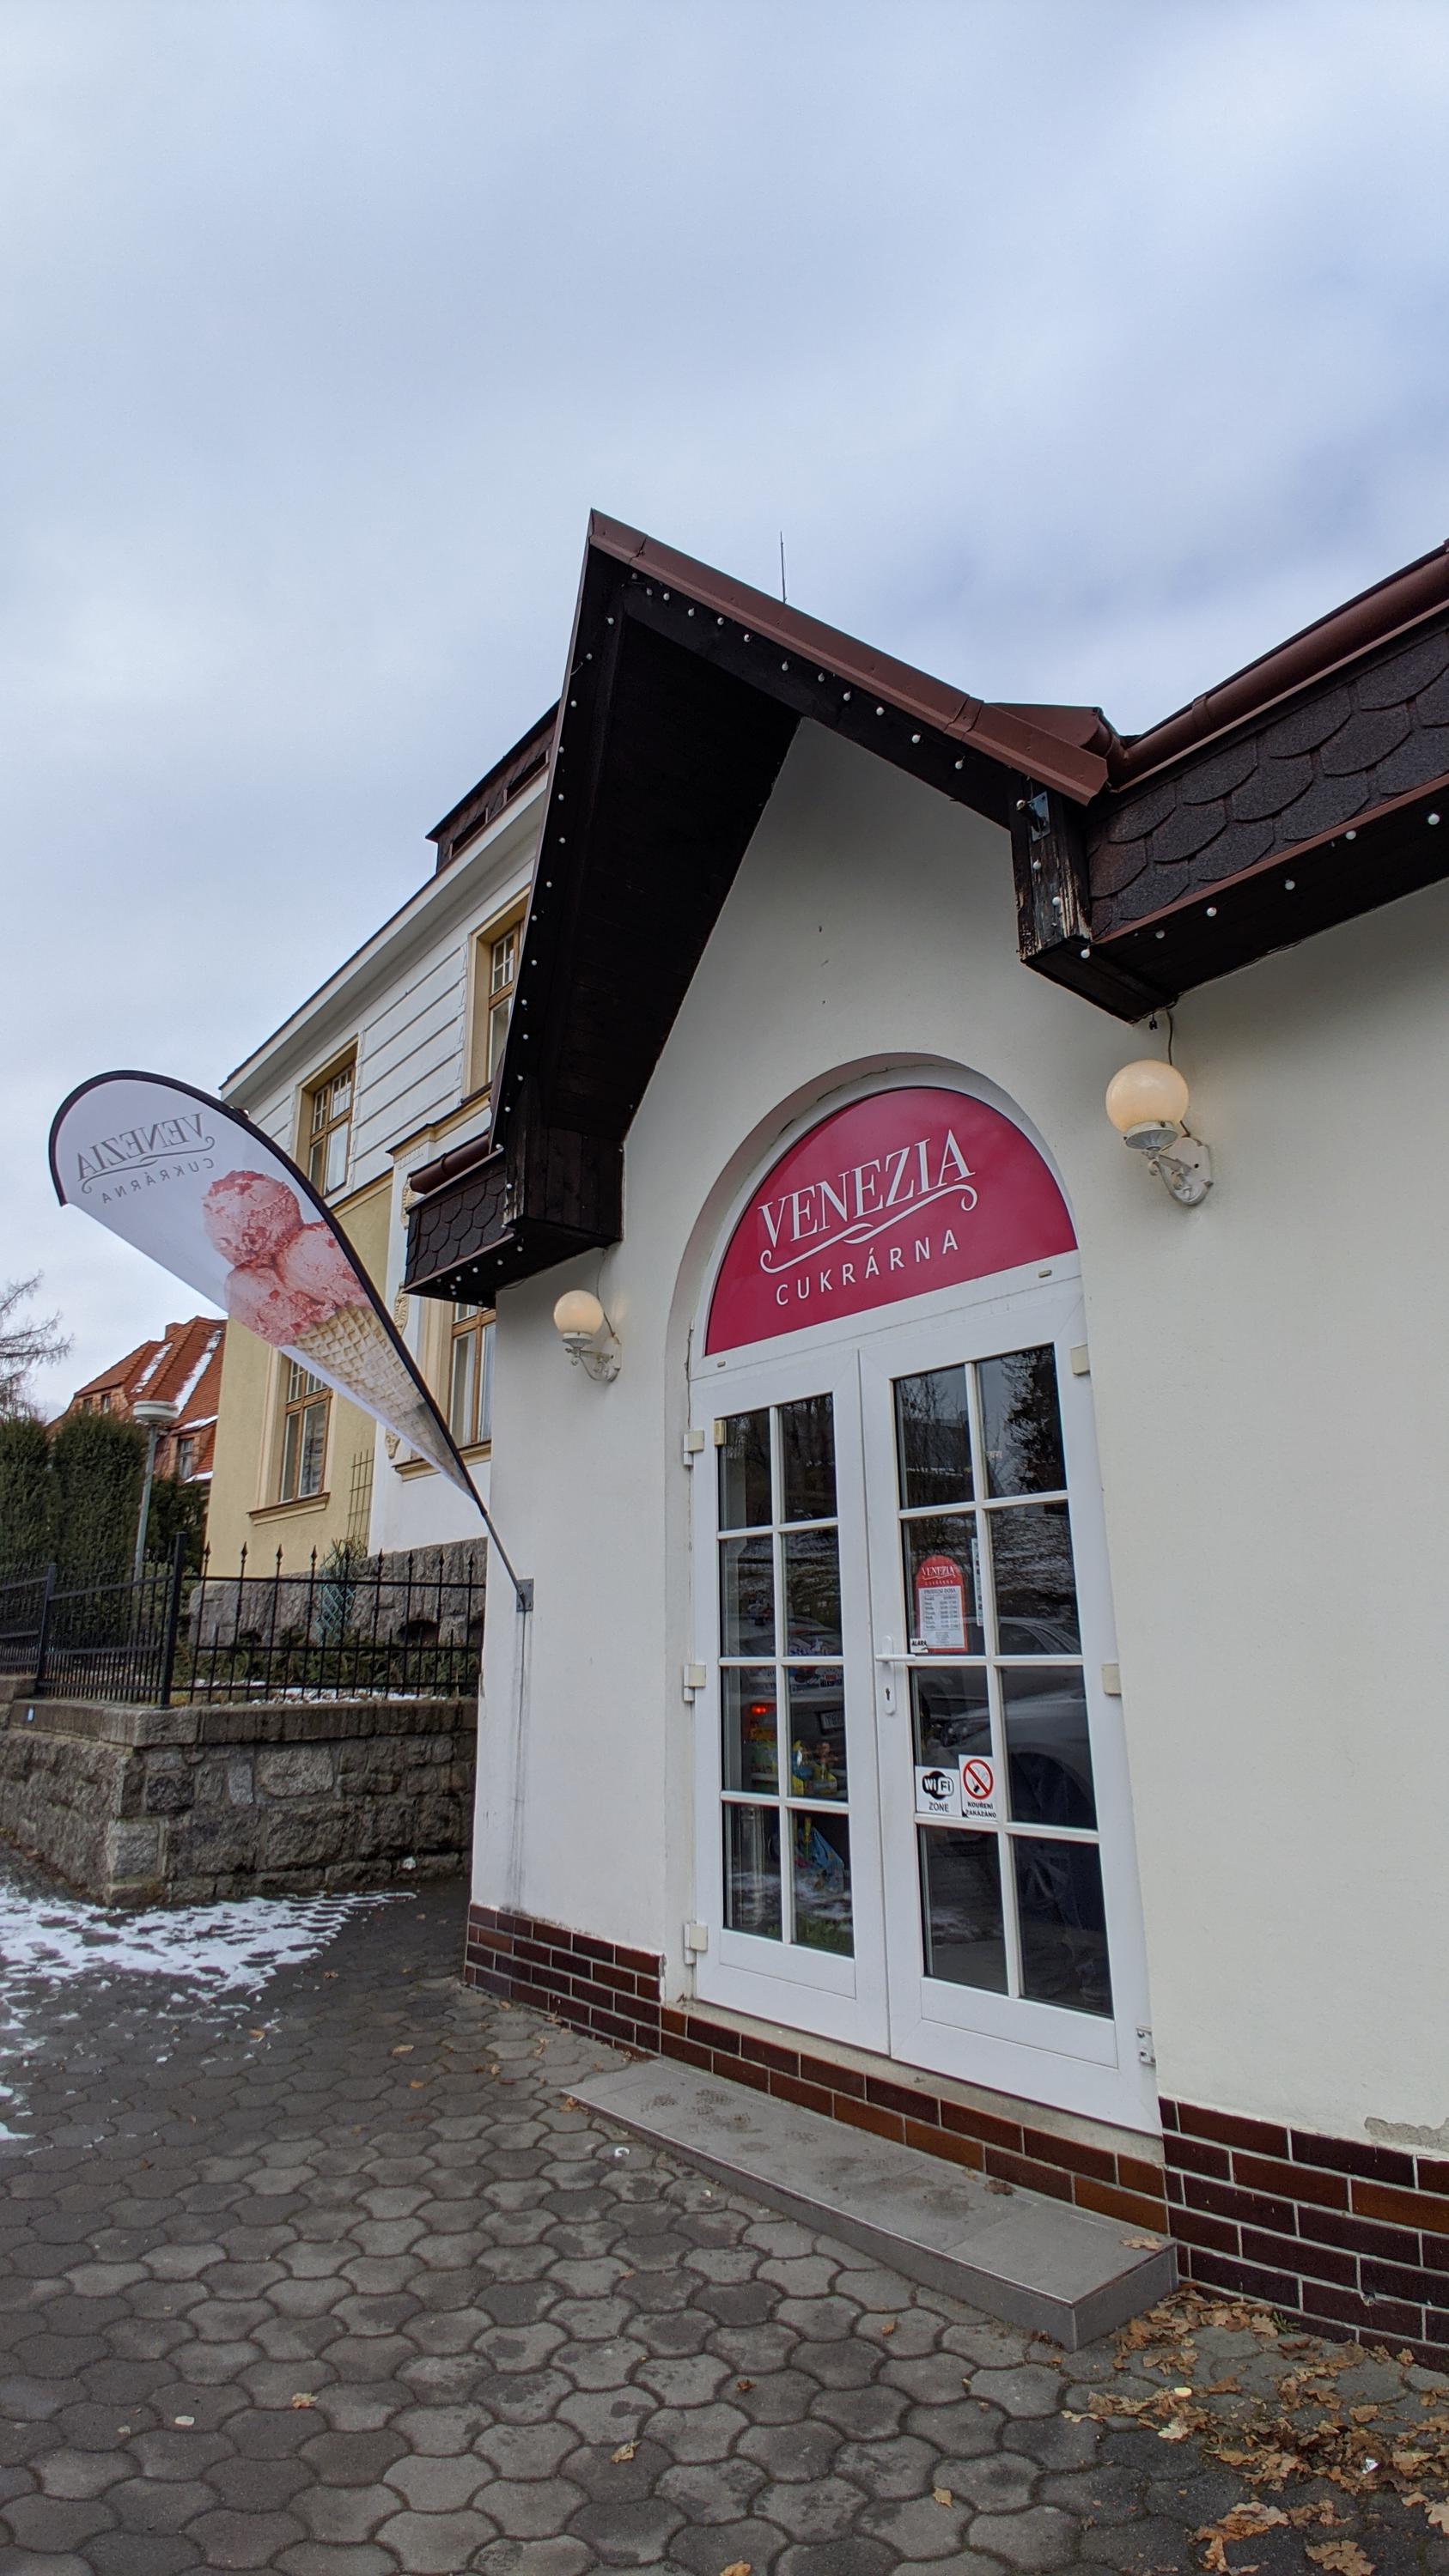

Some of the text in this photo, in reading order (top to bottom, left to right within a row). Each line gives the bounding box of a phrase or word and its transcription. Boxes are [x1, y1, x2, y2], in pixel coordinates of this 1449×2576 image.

[758, 1129, 976, 1248] VENEZIA
[776, 1230, 959, 1306] CUKRÁRNA
[921, 1565, 955, 1577] VENEZIA
[928, 1802, 949, 1812] ZONE
